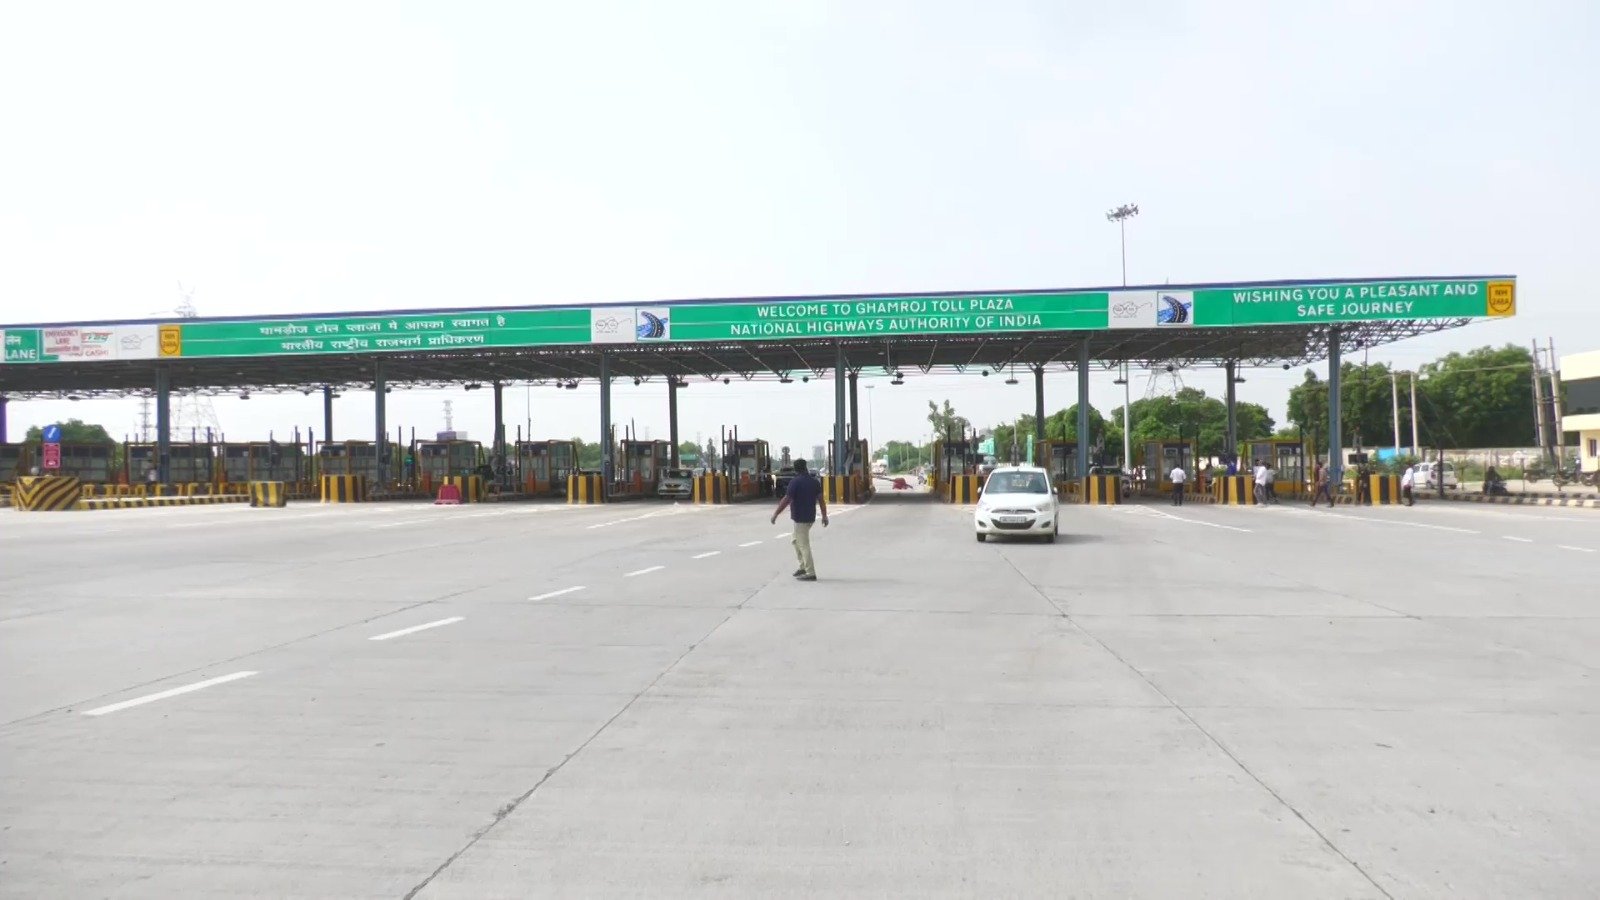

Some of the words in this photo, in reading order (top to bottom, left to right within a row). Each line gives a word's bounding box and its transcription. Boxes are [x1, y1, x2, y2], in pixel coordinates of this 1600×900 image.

[1233, 289, 1303, 303] WISHING
[1307, 287, 1340, 300] YOU
[1345, 287, 1355, 299] A
[1360, 284, 1441, 299] PLEASANT
[1443, 283, 1479, 296] AND
[757, 304, 828, 317] WELCOME
[832, 303, 851, 316] TO
[856, 301, 927, 314] GHAMROJ
[931, 300, 965, 313] TOLL
[970, 298, 1014, 311] PLAZA
[1297, 304, 1335, 317] SAFE
[1340, 301, 1414, 315] JOURNEY
[315, 323, 339, 333] टोल
[405, 320, 444, 330] आपका
[451, 318, 489, 327] स्वागत
[497, 314, 506, 327] है
[730, 322, 802, 335] NATIONAL
[807, 319, 884, 333] HIGHWAYS
[889, 316, 970, 330] AUTHORITY
[975, 315, 994, 328] OF
[999, 314, 1042, 327] INDIA
[281, 338, 323, 350] भारतीय
[375, 335, 421, 347] राजमार्ग
[428, 334, 484, 346] प्राधिकरण
[5, 349, 36, 360] LANE
